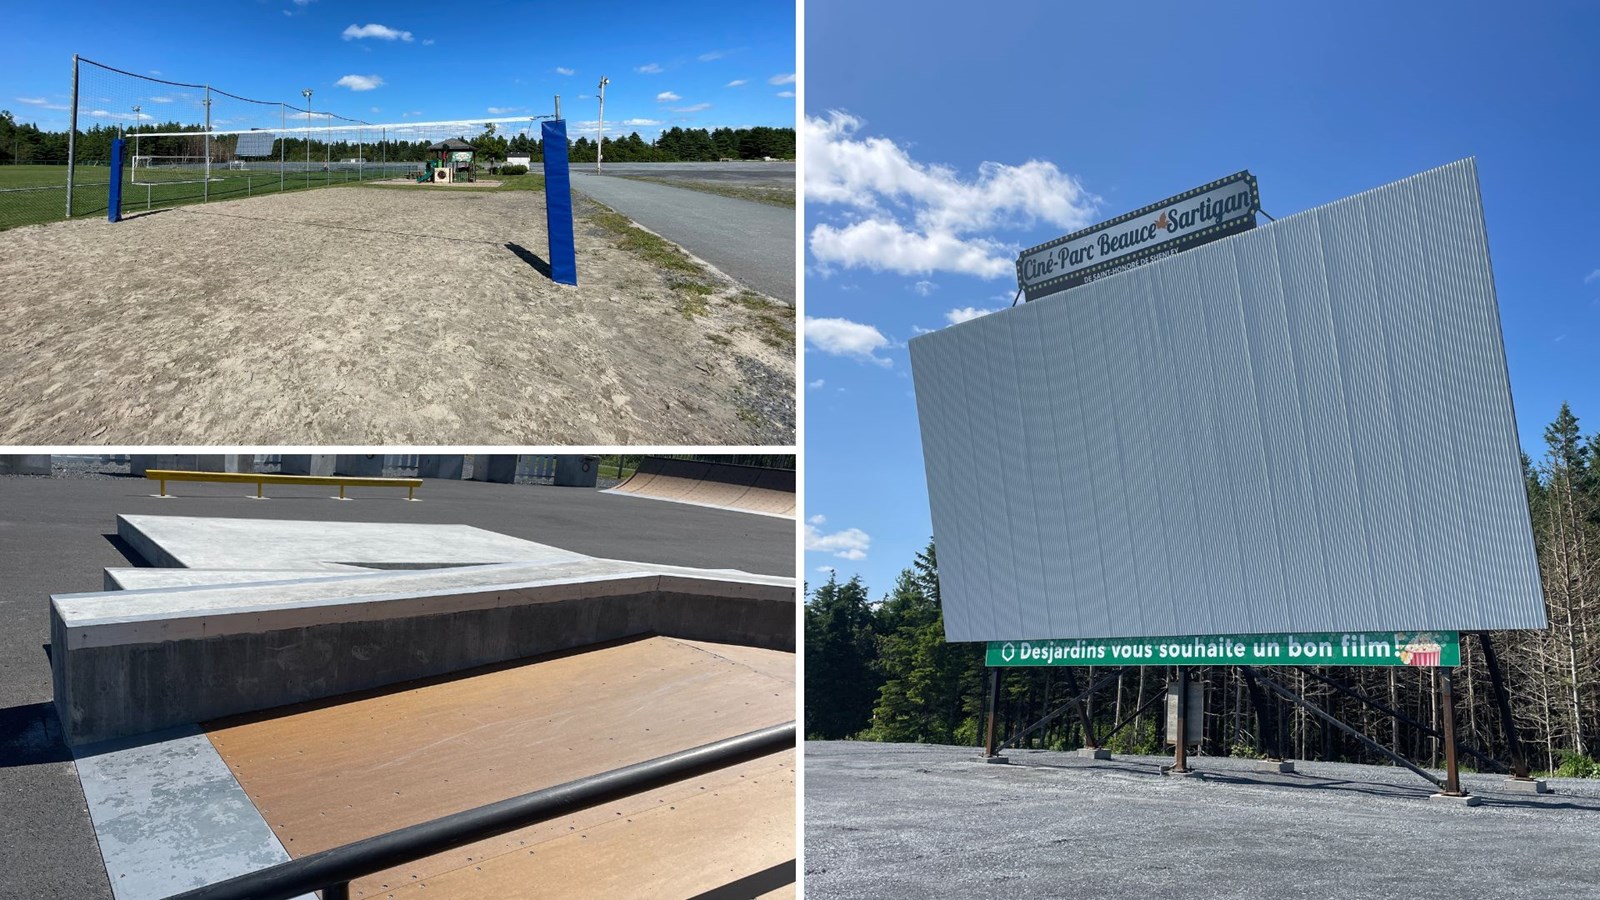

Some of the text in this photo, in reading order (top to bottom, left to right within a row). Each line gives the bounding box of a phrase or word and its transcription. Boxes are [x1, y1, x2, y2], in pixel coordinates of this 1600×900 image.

[1023, 189, 1250, 281] Ciné-Parc Beauce Sartigan
[1084, 275, 1092, 283] DE
[1140, 256, 1149, 265] DE
[1020, 634, 1401, 663] Desjardins vous souhaite un bon film!
